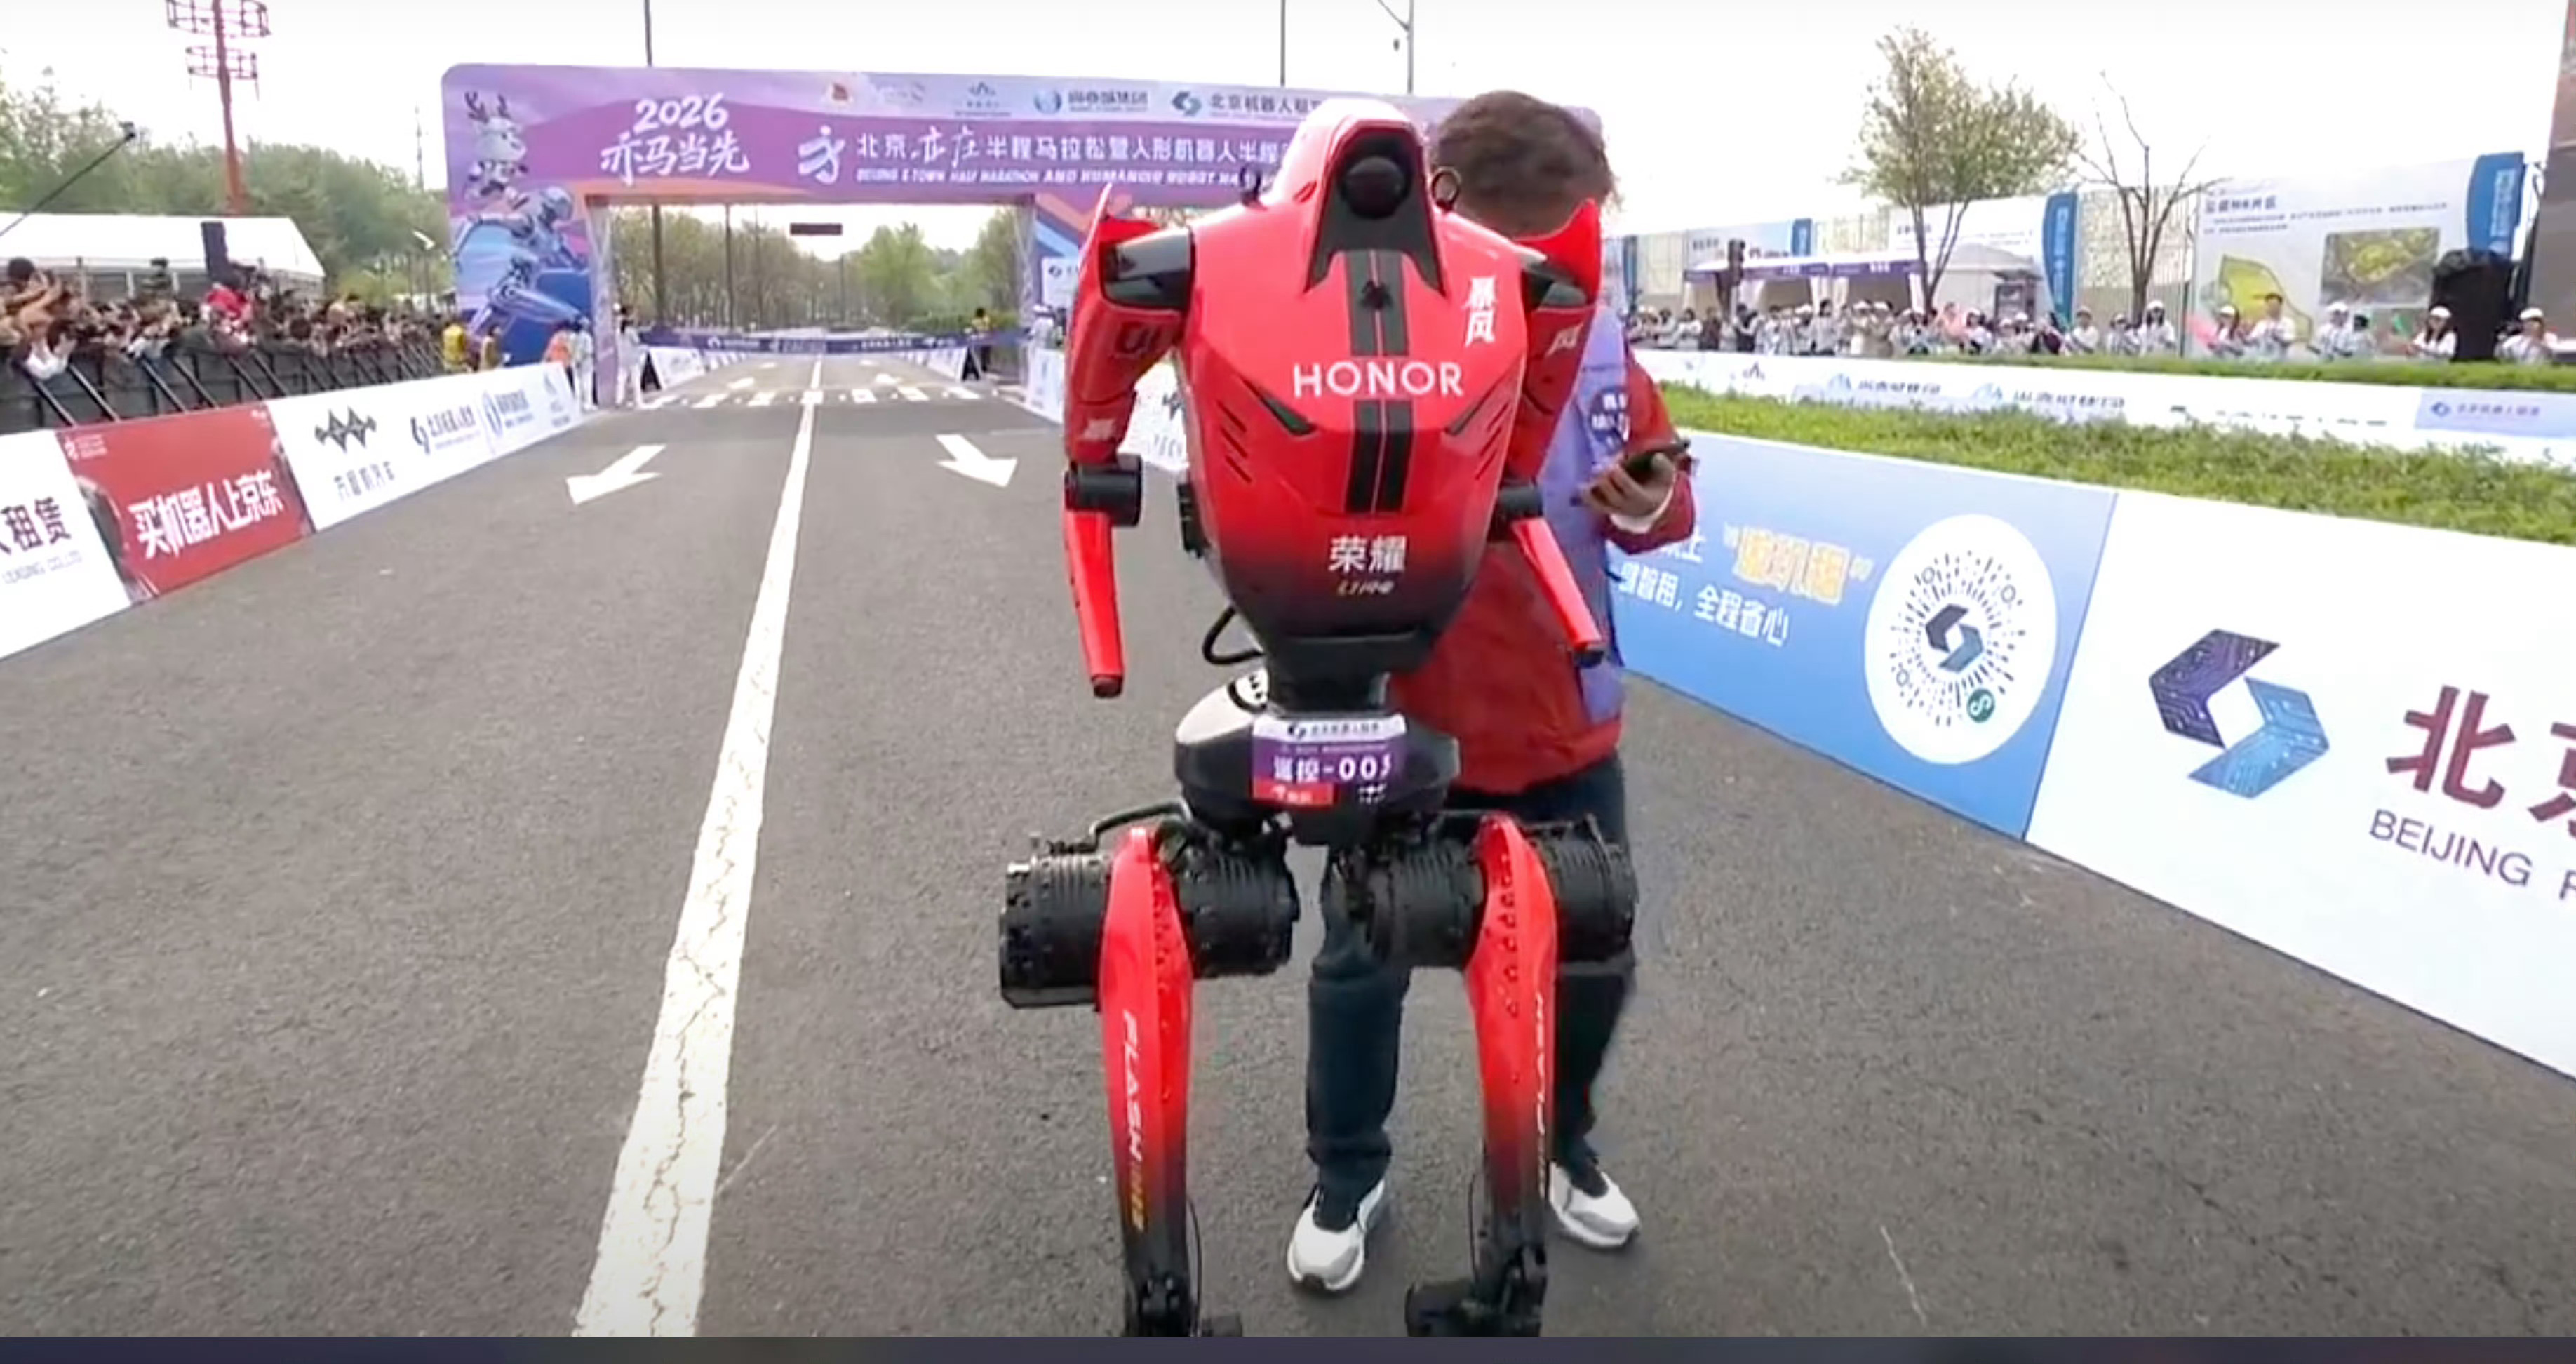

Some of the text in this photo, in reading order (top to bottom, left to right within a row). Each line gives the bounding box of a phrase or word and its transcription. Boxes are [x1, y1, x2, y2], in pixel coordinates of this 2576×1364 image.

[633, 92, 729, 134] 2026
[601, 129, 750, 186] 亦马当先
[857, 125, 1289, 168] 北京亦庄半程马拉松暨人形机器人半程
[979, 168, 1038, 182] MARATHON
[1042, 169, 1078, 182] AND
[1081, 169, 1164, 183] HUMANOID
[1293, 360, 1464, 398] HONOR
[128, 469, 284, 559] 买机器人上京东
[1328, 535, 1407, 573] 荣耀
[2369, 809, 2533, 887] BEIJING
[1123, 1009, 1143, 1162] FLASH
